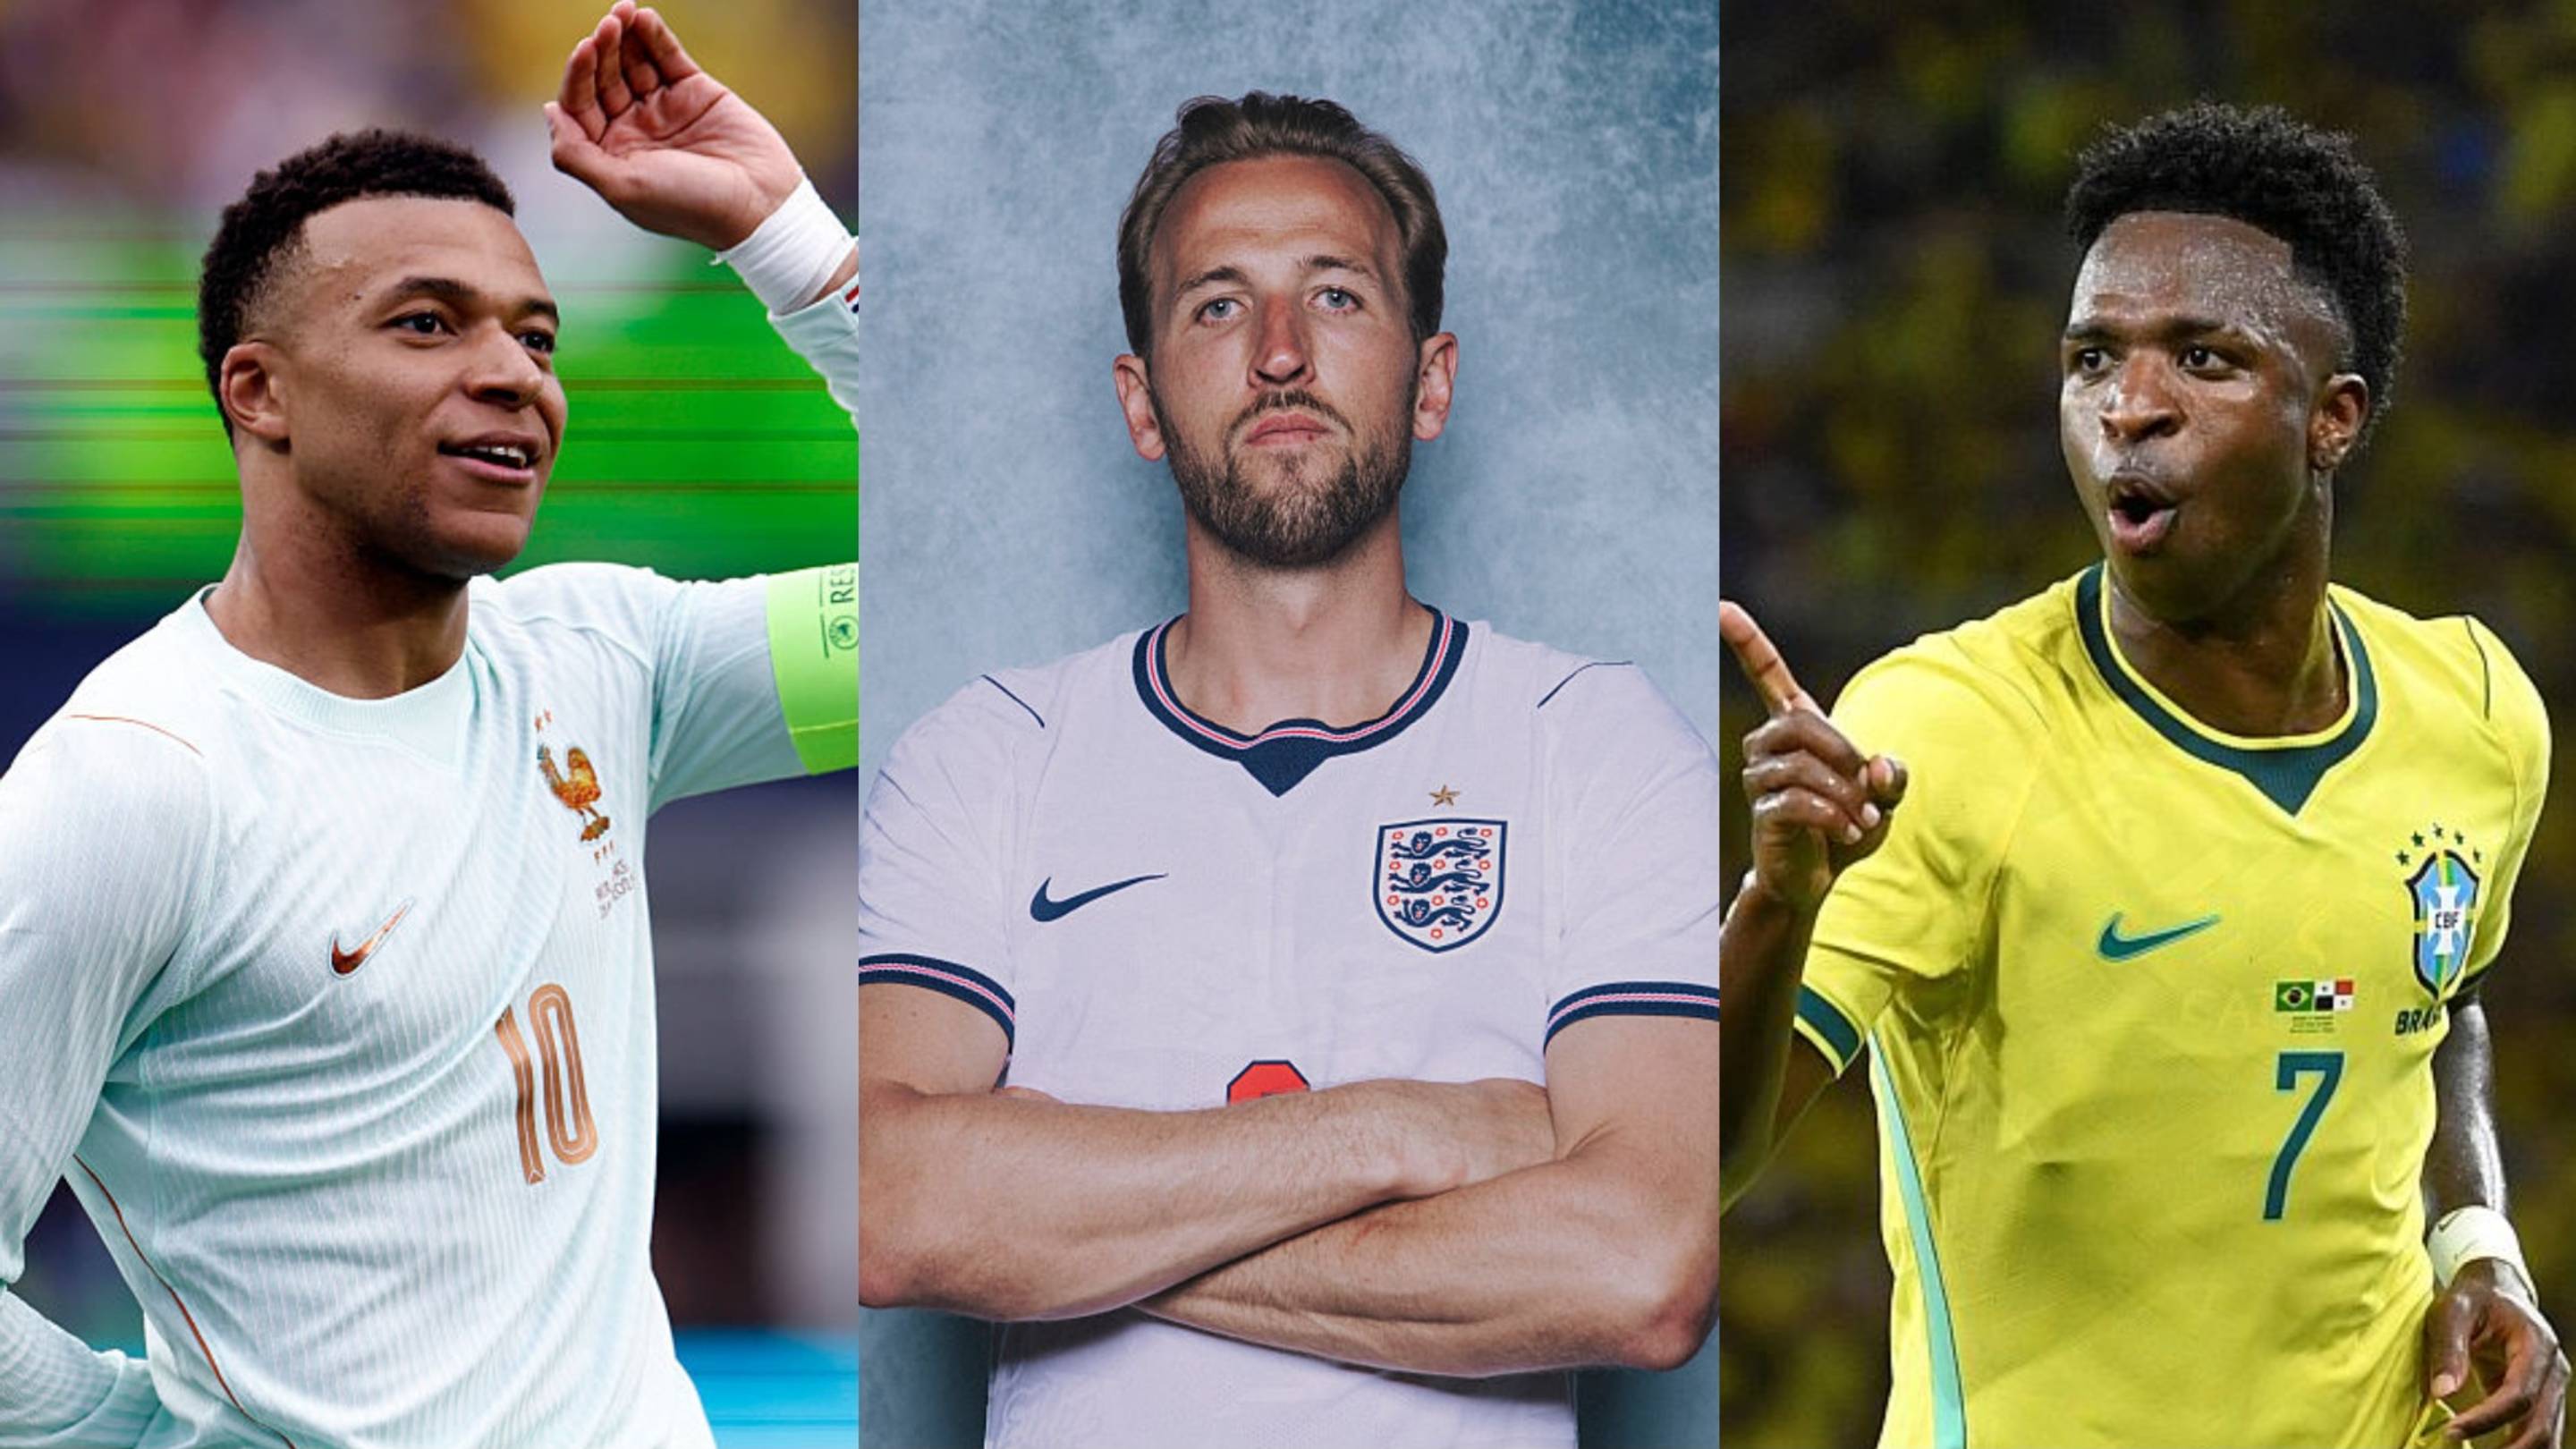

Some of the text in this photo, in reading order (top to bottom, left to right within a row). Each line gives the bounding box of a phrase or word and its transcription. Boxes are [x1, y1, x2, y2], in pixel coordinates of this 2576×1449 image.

[2434, 911, 2460, 929] CBF
[494, 982, 598, 1186] 10
[2263, 1052, 2344, 1220] 7
